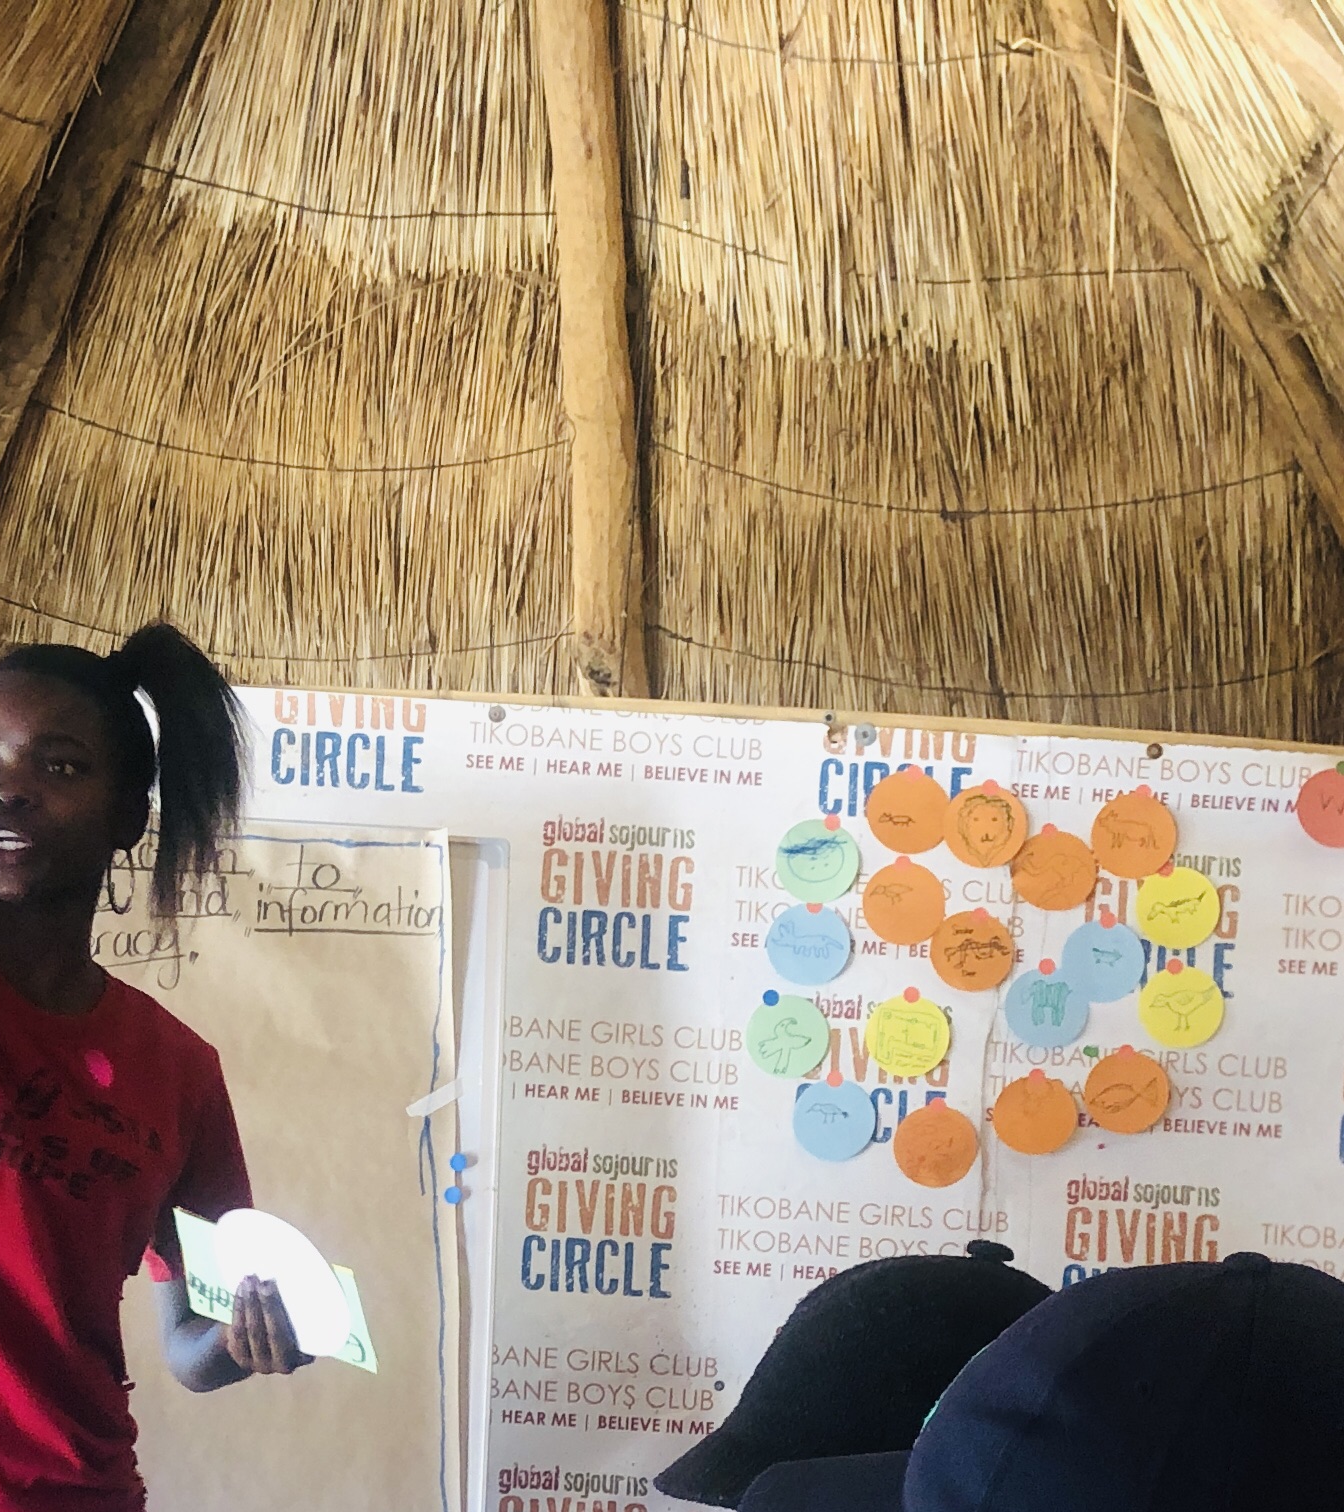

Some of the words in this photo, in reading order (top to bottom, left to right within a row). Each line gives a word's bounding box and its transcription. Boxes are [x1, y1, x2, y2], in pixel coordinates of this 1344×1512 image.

[470, 721, 603, 750] TIKOBANE
[613, 729, 683, 757] BOYS
[693, 734, 763, 760] CLUB
[271, 728, 425, 793] CIRCLE
[466, 754, 494, 770] SEE
[499, 756, 525, 772] ME
[547, 759, 591, 776] HEAR
[597, 762, 623, 778] ME
[644, 765, 708, 783] BELIEVE
[714, 769, 731, 785] IN
[737, 770, 763, 786] ME
[1017, 749, 1152, 779] TIKOBANE
[1160, 758, 1231, 785] BOYS
[1011, 782, 1039, 799] SEE
[1045, 785, 1070, 800] ME
[1191, 794, 1256, 812] BELIEVE
[1261, 797, 1279, 812] IN
[543, 814, 605, 846] global
[608, 822, 696, 851] sojourns
[284, 843, 341, 889] to
[540, 848, 695, 912] GIVING
[257, 888, 444, 938] information
[537, 906, 690, 971] CIRCLE
[731, 932, 759, 948] SEE
[861, 941, 887, 955] ME
[1277, 959, 1306, 975] SEE
[1312, 961, 1338, 976] ME
[505, 1015, 581, 1042] BANE
[590, 1020, 664, 1047] GIRLS
[674, 1026, 743, 1052] CLUB
[505, 1049, 581, 1076] BANE
[590, 1054, 660, 1081] BOYS
[669, 1060, 739, 1086] CLUB
[1218, 1053, 1288, 1080] CLUB
[525, 1083, 570, 1100] HEAR
[575, 1086, 601, 1101] ME
[621, 1088, 685, 1107] BELIEVE
[690, 1093, 707, 1108] IN
[713, 1095, 739, 1110] ME
[1212, 1088, 1283, 1114] CLUB
[1163, 1117, 1228, 1136] BELIEVE
[1233, 1121, 1251, 1136] IN
[1257, 1123, 1282, 1139] ME
[526, 1143, 588, 1176] global
[592, 1153, 679, 1181] sojourns
[525, 1177, 678, 1239] GIVING
[1067, 1173, 1130, 1205] global
[1133, 1182, 1221, 1210] sojourns
[718, 1194, 850, 1223] TIKOBANE
[859, 1202, 933, 1229] GIRLS
[943, 1208, 1009, 1233] CLUB
[718, 1228, 850, 1258] TIKOBANE
[1064, 1206, 1220, 1264] GIVING
[521, 1235, 673, 1299] CIRCLE
[713, 1260, 742, 1276] SEE
[746, 1262, 772, 1278] ME
[567, 1348, 640, 1374] GIRLS
[649, 1352, 719, 1379] CLUB
[567, 1381, 637, 1408] BOYS
[646, 1386, 715, 1411] CLUB
[501, 1410, 546, 1427] HEAR
[551, 1412, 577, 1428] ME
[597, 1415, 661, 1433] BELIEVE
[666, 1419, 684, 1435] IN
[689, 1421, 716, 1436] ME
[498, 1464, 560, 1494] global
[563, 1472, 649, 1498] sojourns
